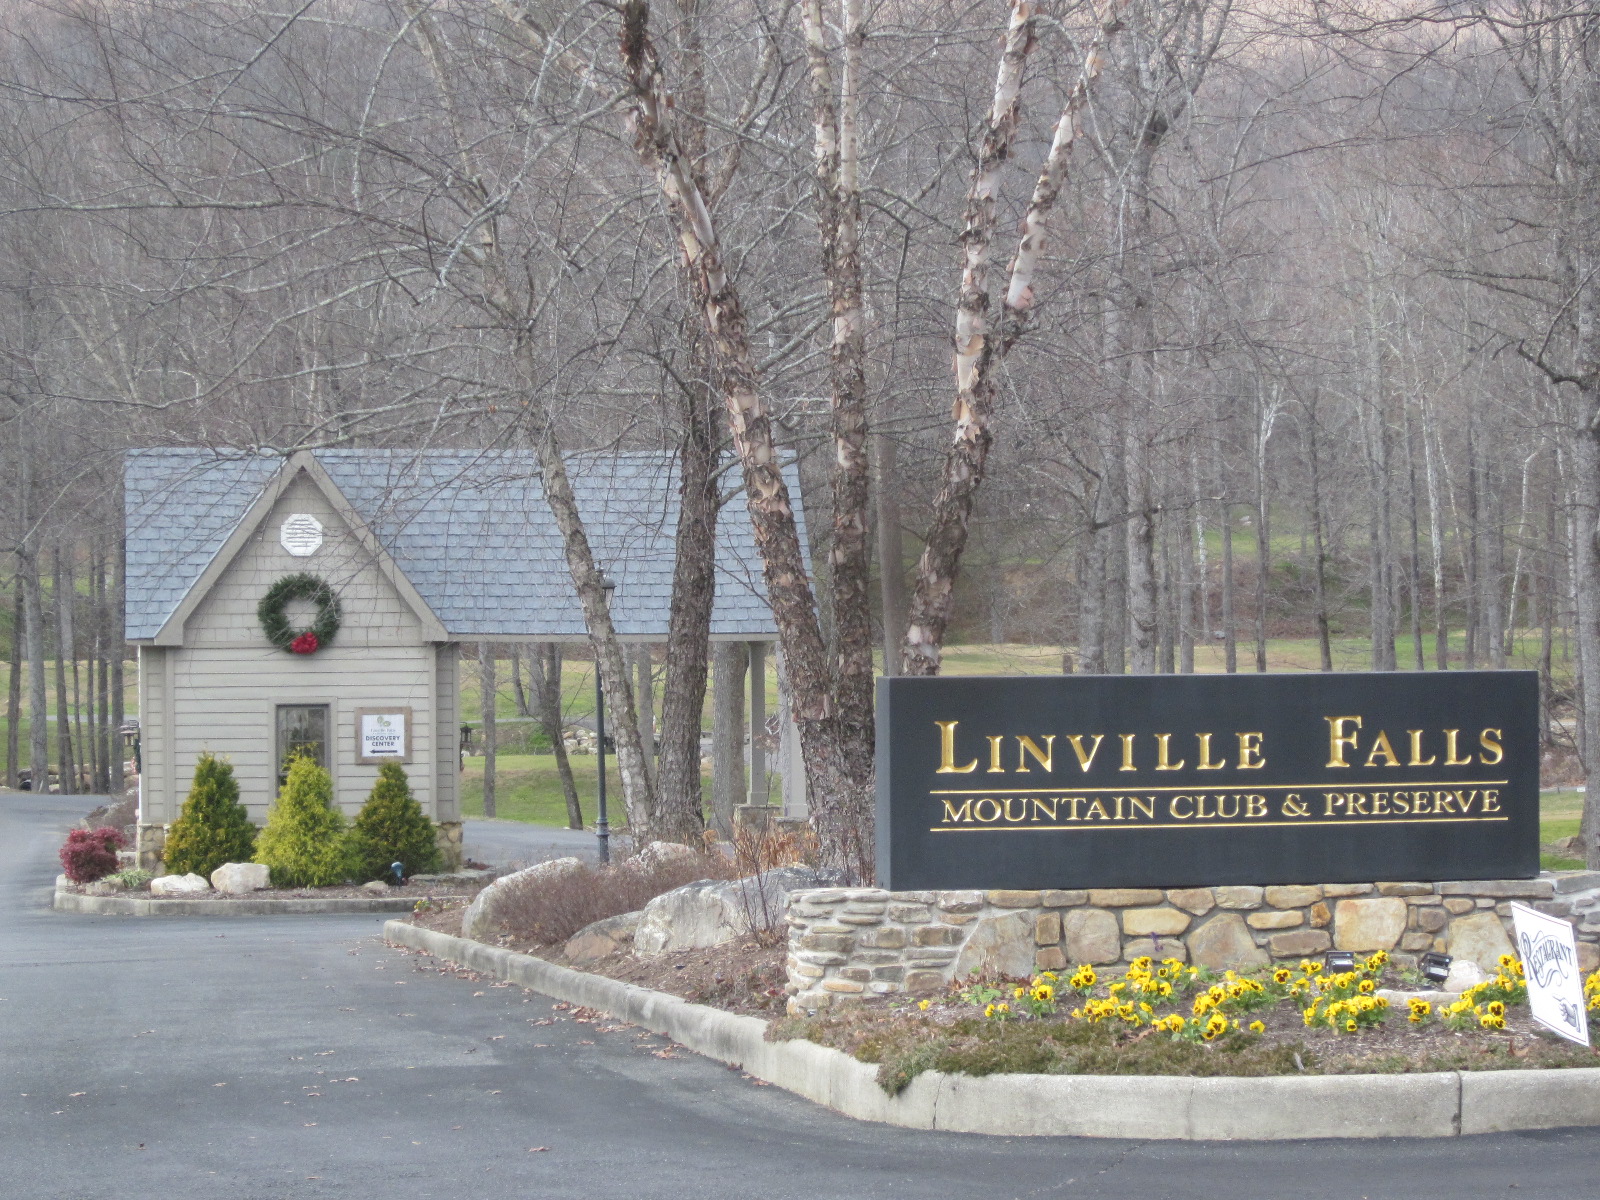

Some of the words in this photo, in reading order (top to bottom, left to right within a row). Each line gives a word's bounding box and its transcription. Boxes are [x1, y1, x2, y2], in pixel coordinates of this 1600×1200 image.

[934, 720, 1266, 774] LINVILLE
[1323, 715, 1504, 768] FALLS
[941, 796, 1156, 823] MOUNTAIN
[1169, 794, 1268, 819] CLUB
[1281, 793, 1311, 817] &
[1323, 789, 1501, 816] PRESERVE
